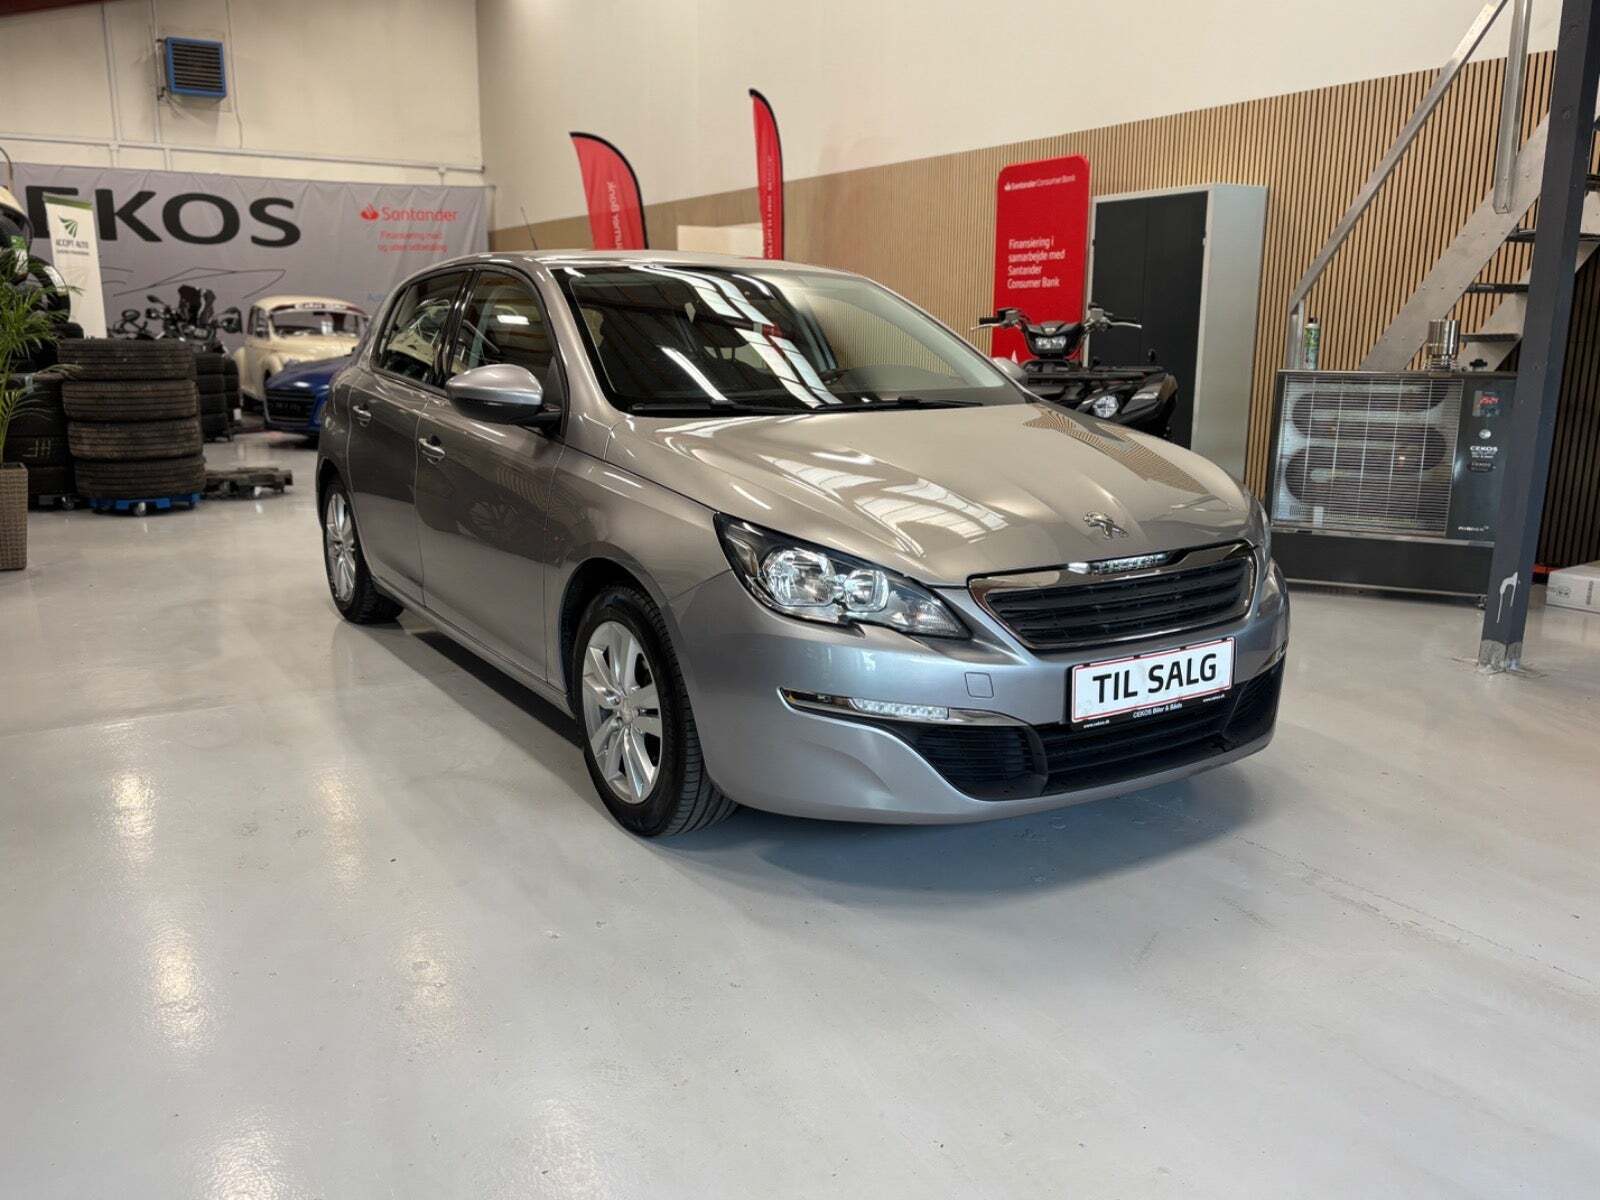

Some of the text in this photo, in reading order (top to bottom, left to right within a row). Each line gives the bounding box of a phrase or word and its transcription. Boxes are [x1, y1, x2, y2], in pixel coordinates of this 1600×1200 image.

[382, 206, 459, 221] Santander
[1008, 237, 1051, 250] Finansiering
[1008, 249, 1066, 264] samarbejde med
[1007, 264, 1042, 275] Santander
[1007, 276, 1060, 289] Consumer Bank
[1092, 653, 1217, 703] TIL SALG
